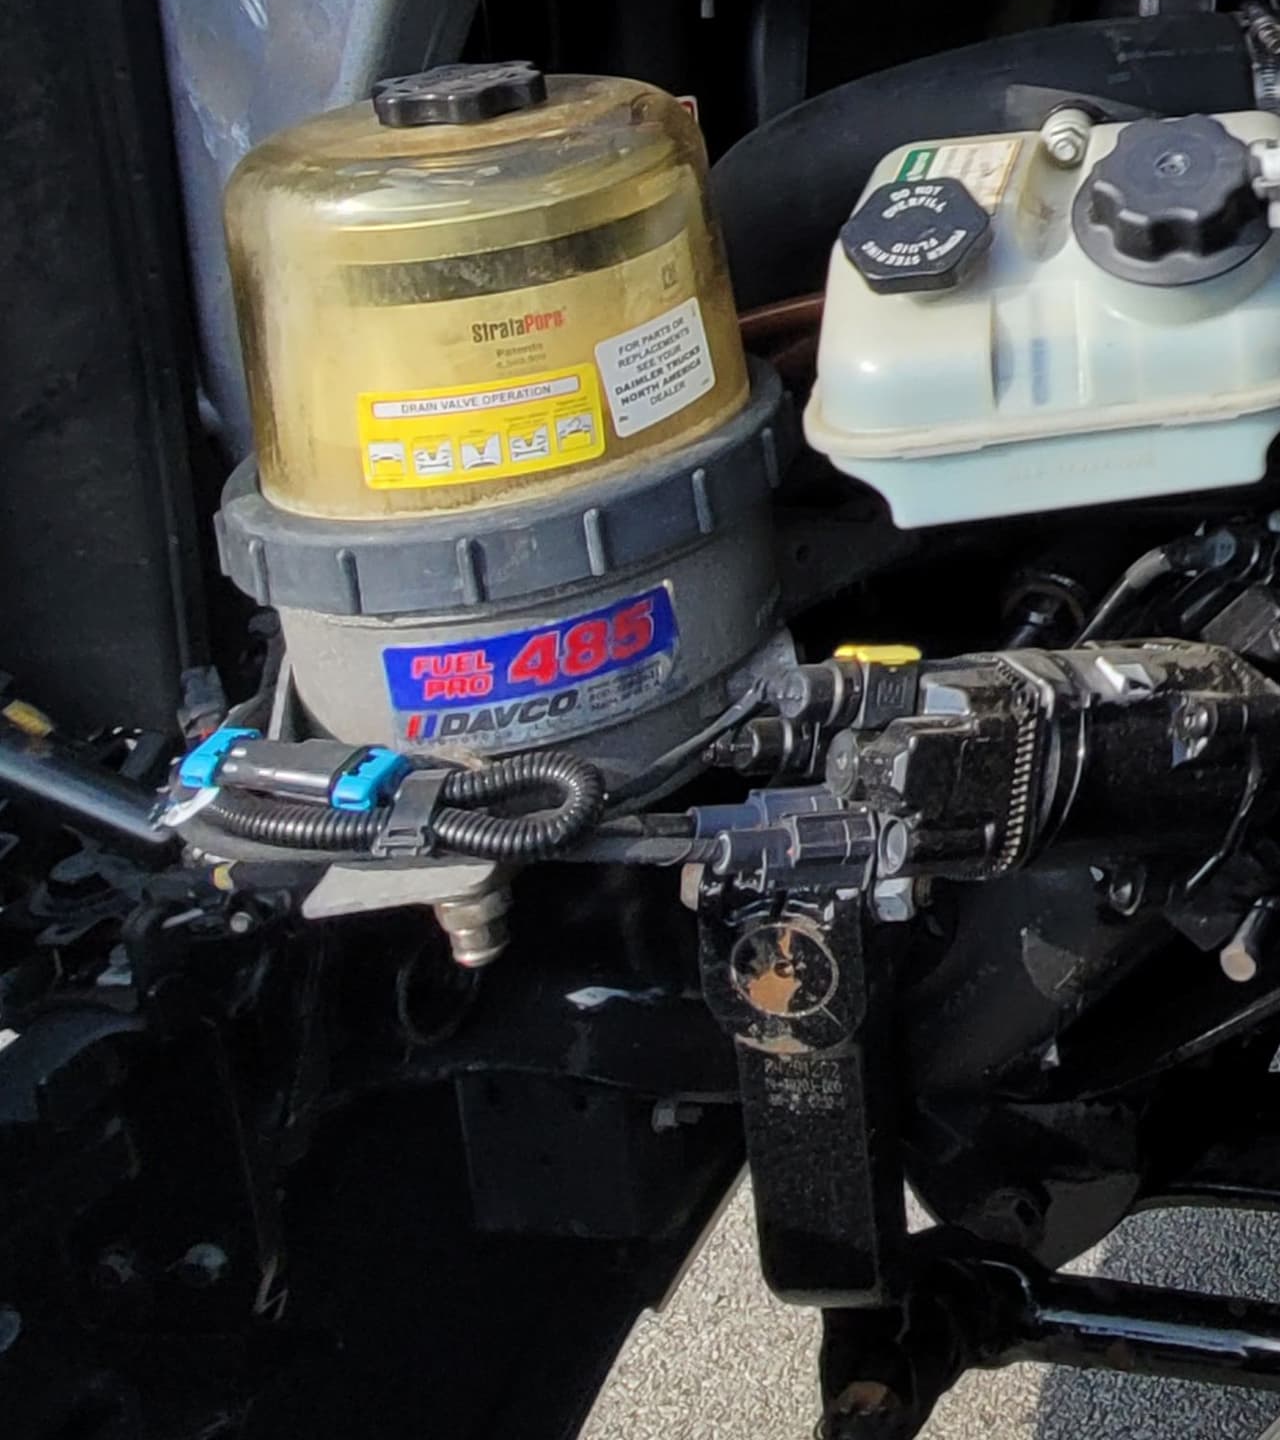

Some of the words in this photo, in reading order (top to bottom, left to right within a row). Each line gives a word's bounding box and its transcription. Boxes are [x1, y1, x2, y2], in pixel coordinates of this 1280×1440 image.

[882, 196, 948, 219] OVERFILL
[889, 187, 912, 202] DO
[914, 185, 944, 197] NOT
[860, 240, 922, 267] STEERING
[891, 236, 939, 254] FLUID
[926, 229, 968, 261] POWER
[617, 327, 690, 369] REPLACEMENTS
[618, 338, 640, 356] FOR
[641, 324, 671, 349] PARTS
[671, 316, 685, 332] OR
[614, 366, 665, 395] DAIMLER
[666, 345, 701, 374] TRUCKS
[636, 357, 655, 374] SEE
[655, 344, 683, 366] YOUR
[620, 383, 660, 407] NORTH
[661, 358, 702, 391] AMERICA
[649, 379, 687, 407] DEALER
[401, 403, 437, 415] DRAIN
[441, 396, 477, 410] VALVE
[481, 383, 551, 405] OPERATION
[508, 601, 654, 685] 485
[411, 649, 493, 680] FUEL
[423, 673, 493, 701] PRO
[440, 689, 579, 737] DAVCO
